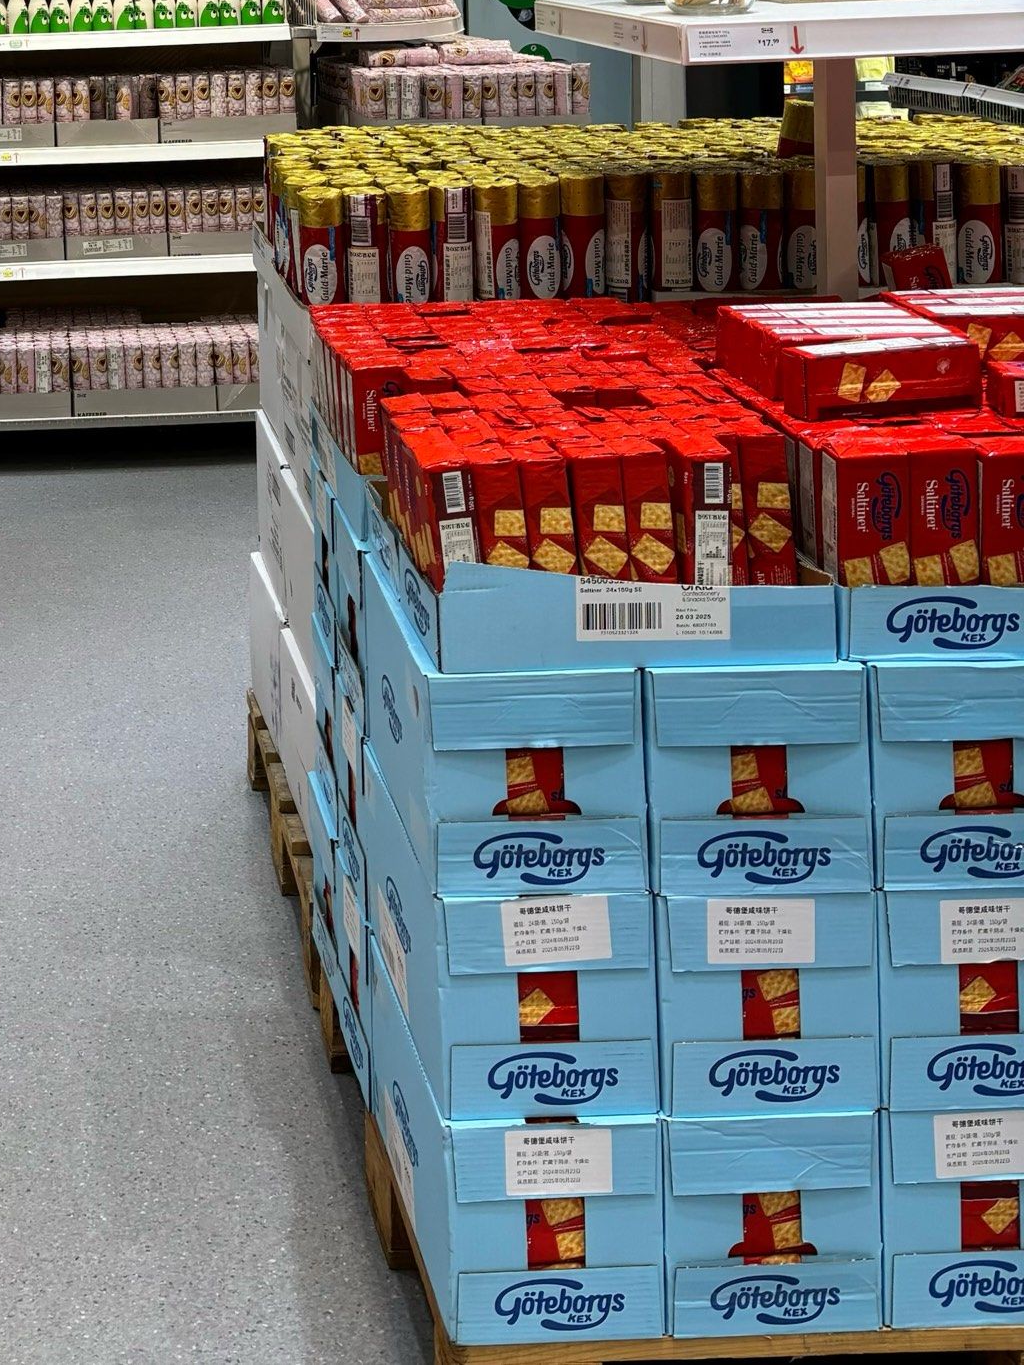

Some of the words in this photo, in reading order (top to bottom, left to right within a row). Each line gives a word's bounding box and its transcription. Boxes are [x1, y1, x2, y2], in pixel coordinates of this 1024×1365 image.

[547, 242, 555, 267] Marie
[714, 234, 724, 261] Marie
[321, 252, 329, 277] Marie
[404, 254, 413, 277] Guld
[714, 262, 724, 286] Guld
[321, 278, 329, 302] Guld
[405, 278, 413, 303] Marie
[547, 268, 555, 292] Guld
[366, 390, 377, 432] Saltiner
[856, 482, 870, 533] Saltiner
[872, 470, 903, 541] Göteborgs
[926, 479, 939, 531] Saltiner
[940, 468, 971, 539] Göteborgs
[1001, 478, 1014, 530] Saltiner
[886, 596, 1020, 649] Göteborgs
[961, 633, 986, 642] KEX
[473, 832, 605, 885] Göteborgs
[697, 830, 831, 885] Göteborgs
[994, 862, 1020, 871] KEX
[548, 867, 573, 877] KEX
[772, 867, 798, 877] KEX
[519, 904, 571, 915] 哥德堡咸味饼干
[726, 906, 778, 914] 哥德堡咸味饼干
[958, 906, 1010, 914] 哥德堡咸味饼干
[488, 1051, 619, 1105] Göteborgs
[709, 1049, 840, 1102] Göteborgs
[561, 1088, 586, 1098] KEX
[782, 1085, 807, 1095] KEX
[952, 1118, 1004, 1128] 哥德堡咸味饼干
[523, 1136, 575, 1145] 哥德堡咸味饼干
[495, 1278, 625, 1331] Göteborgs
[710, 1275, 841, 1325] Göteborgs
[567, 1314, 592, 1323] KEX
[783, 1308, 808, 1317] KEX
